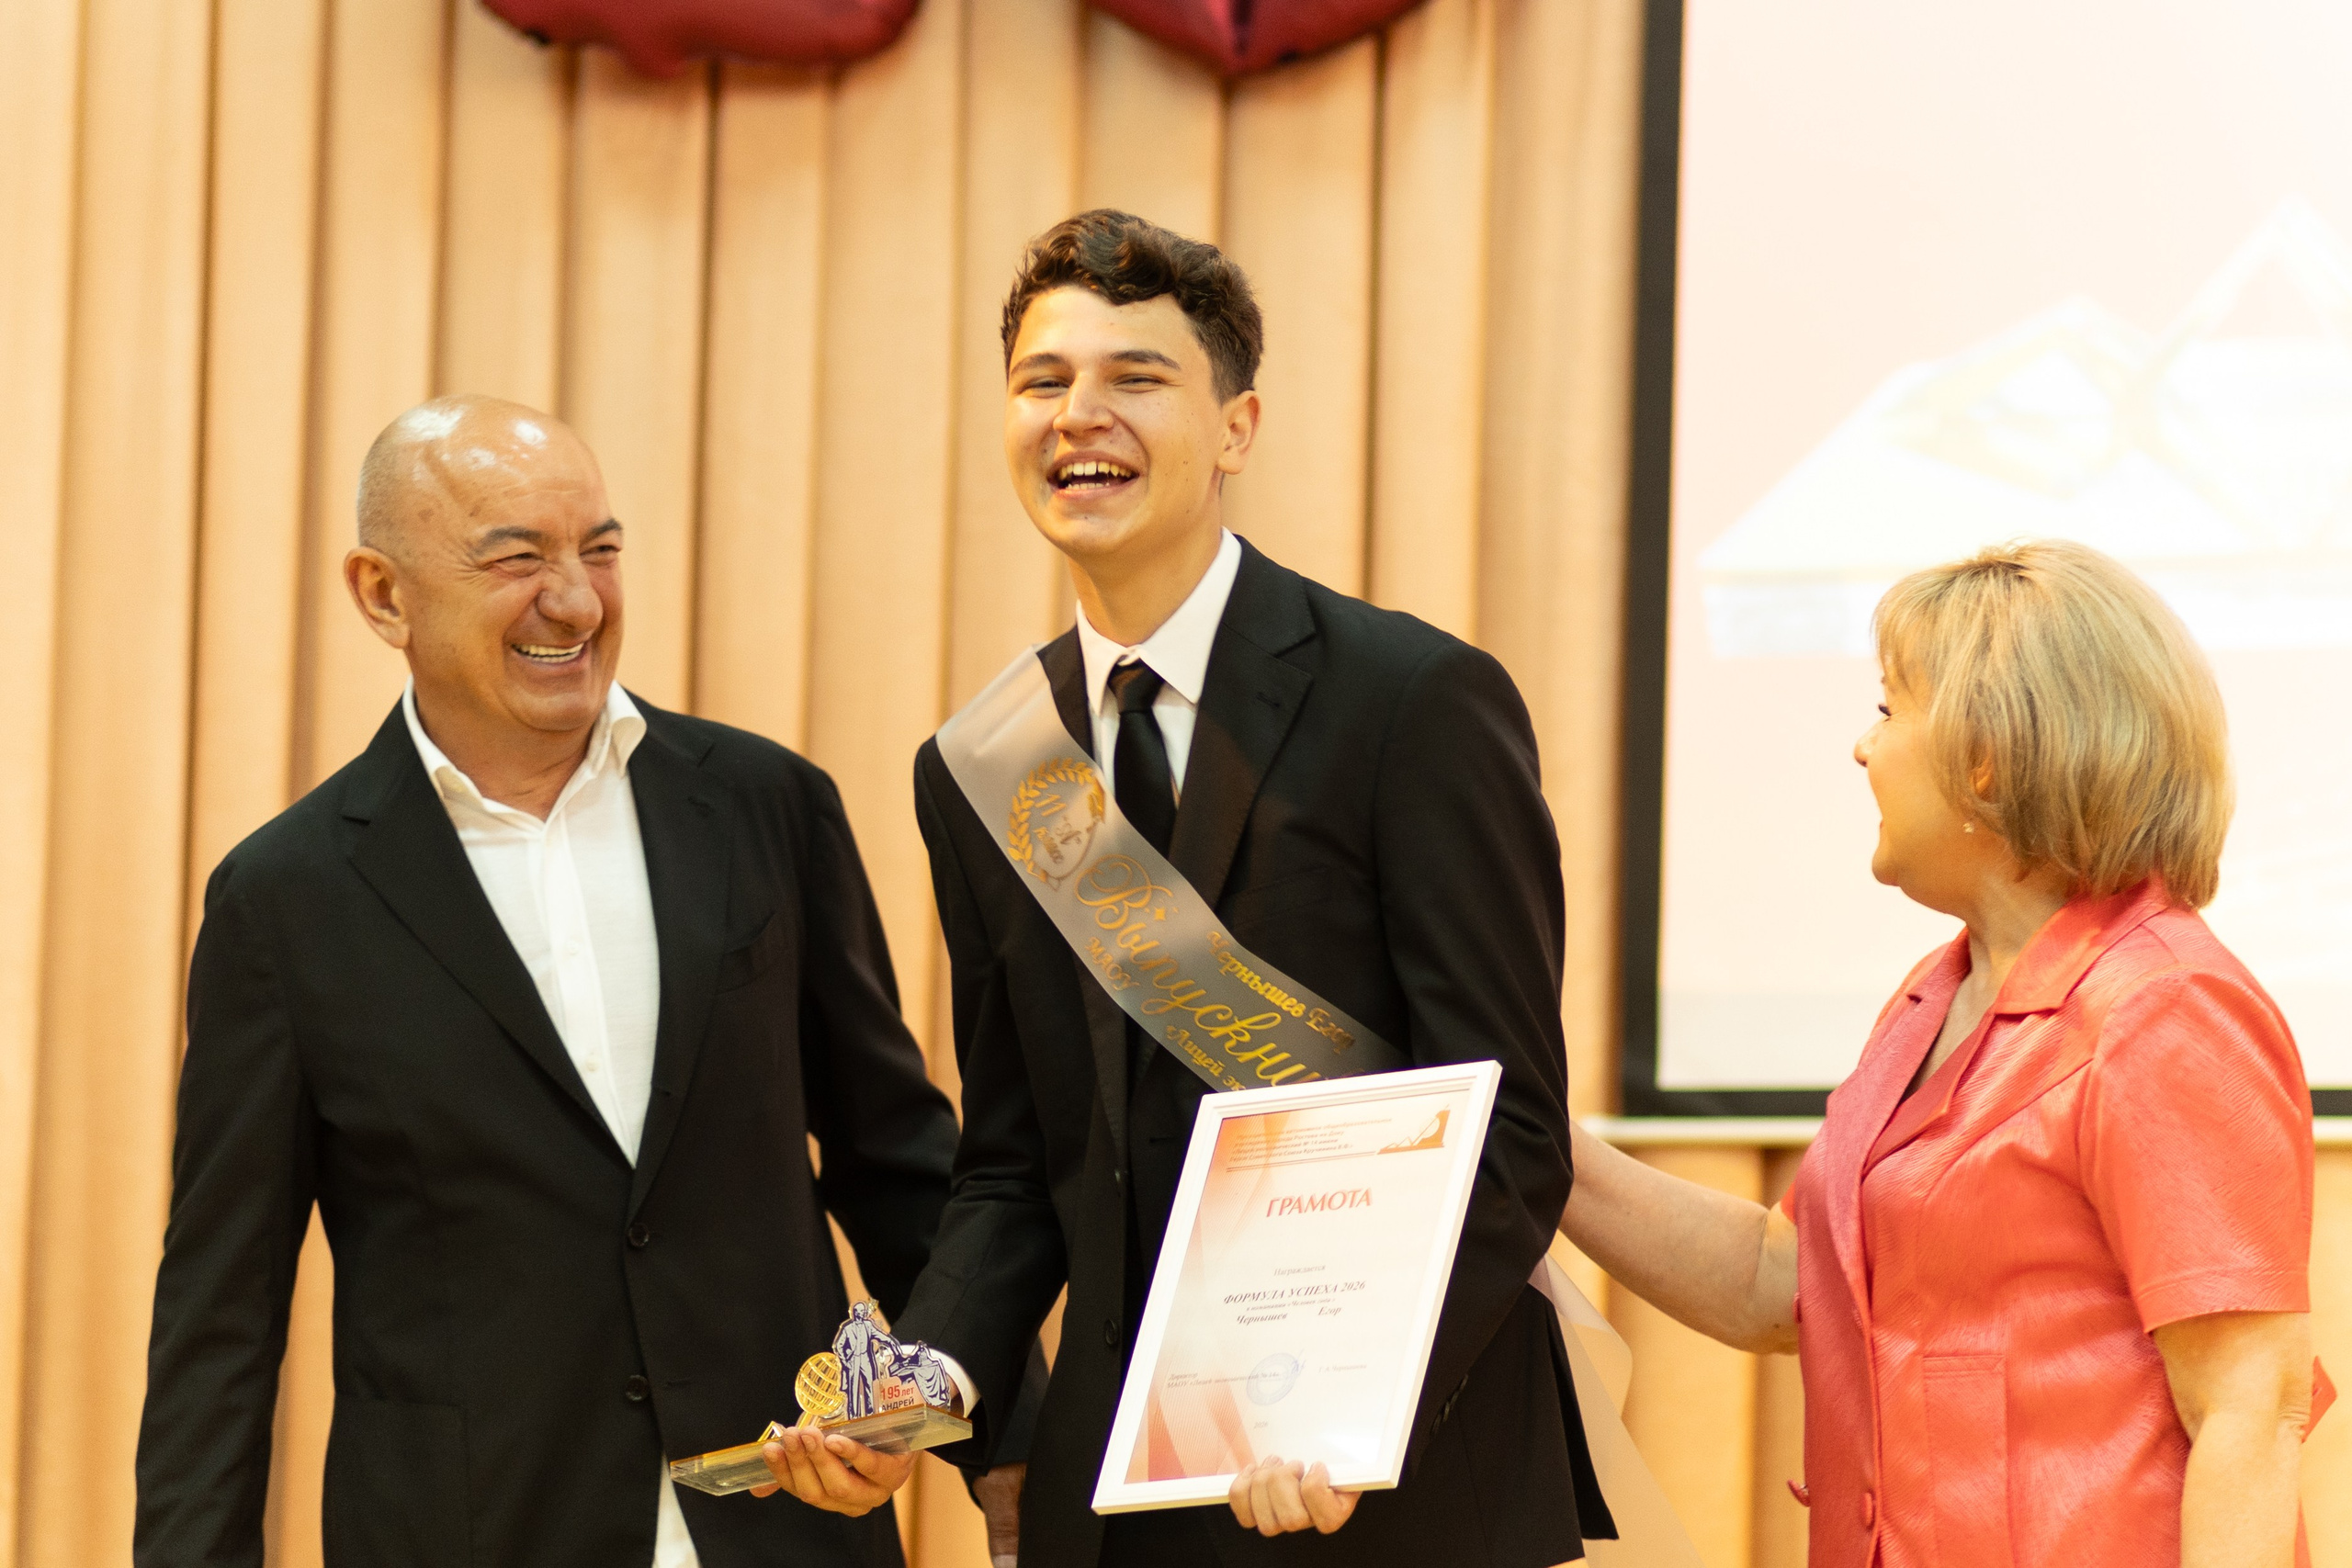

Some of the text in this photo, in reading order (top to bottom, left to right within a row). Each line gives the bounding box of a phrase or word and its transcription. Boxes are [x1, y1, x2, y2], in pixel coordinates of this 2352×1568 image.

[1073, 853, 1321, 1087] Выпускни
[1207, 931, 1356, 1055] Чернышев Егор
[1266, 1188, 1372, 1217] ГРАМОТА
[1273, 1265, 1326, 1276] Награждается
[1224, 1280, 1366, 1304] ФОРМУЛА УСПЕХА 2026
[1237, 1306, 1341, 1325] Чернышев Егор
[880, 1385, 914, 1400] 195 лет
[882, 1396, 914, 1410] АНДРЕЙ
